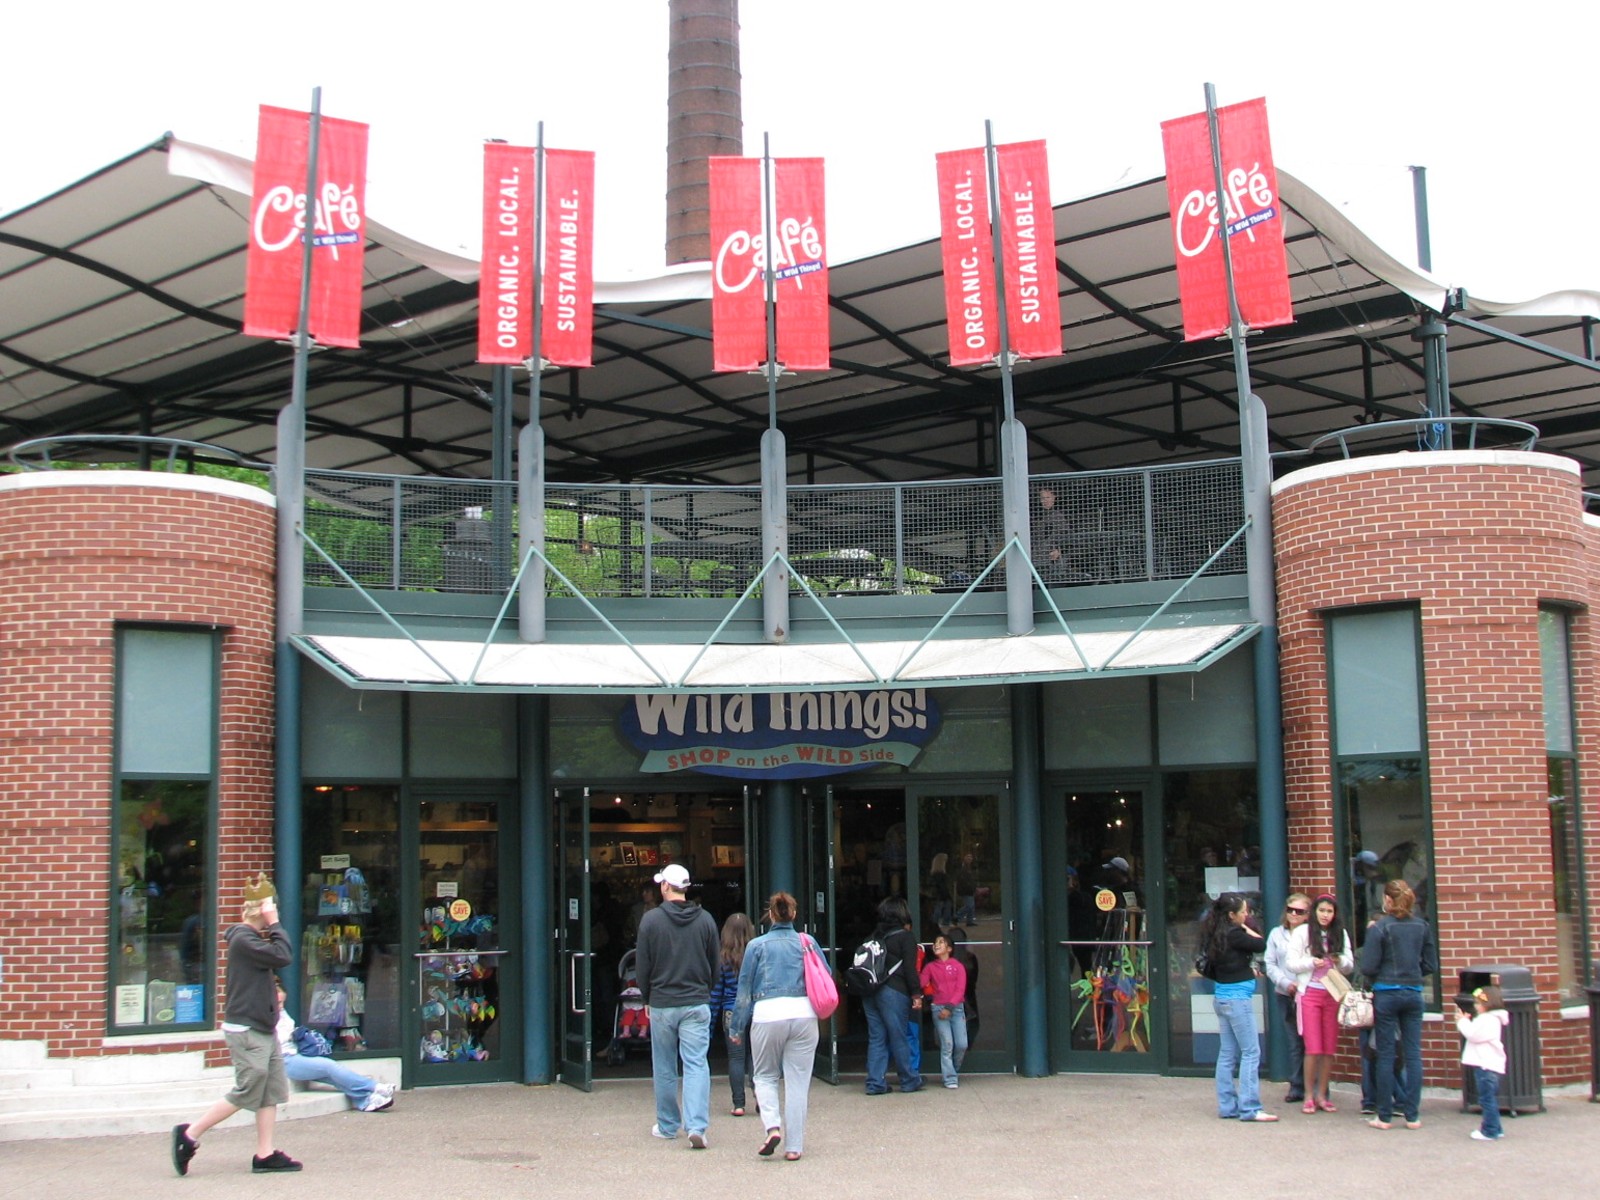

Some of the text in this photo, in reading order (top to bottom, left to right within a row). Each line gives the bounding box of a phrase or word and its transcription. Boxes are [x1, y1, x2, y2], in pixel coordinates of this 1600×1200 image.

[254, 182, 361, 261] Café
[1015, 180, 1041, 324] SUSTAINABLE.
[1176, 162, 1273, 257] Café
[497, 166, 520, 348] ORGANIC. LOCAL.
[557, 188, 579, 331] SUSTAINABLE.
[715, 216, 823, 293] Café
[955, 169, 986, 349] ORGANIC. LOCAL.
[667, 746, 895, 769] SHOP on the WILD Side
[453, 906, 469, 915] SAVE
[1098, 895, 1113, 905] SAVE
